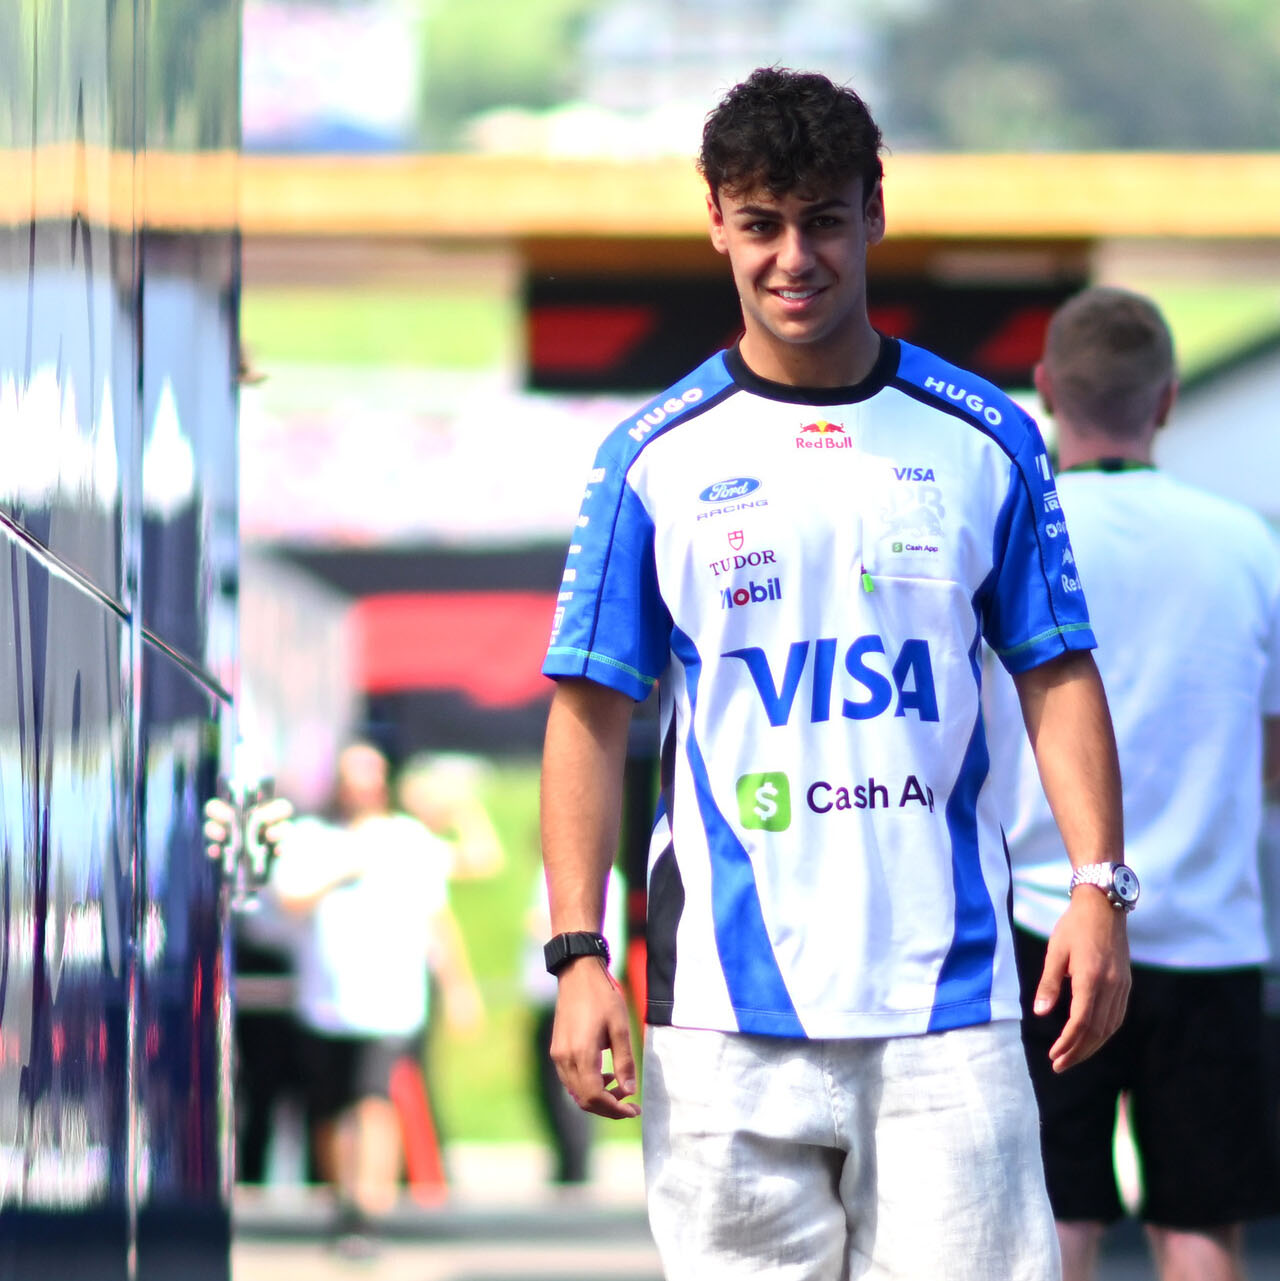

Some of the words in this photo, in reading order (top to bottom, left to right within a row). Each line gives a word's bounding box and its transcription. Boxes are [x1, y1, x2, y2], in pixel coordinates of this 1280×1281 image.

[924, 376, 1002, 425] HUGO
[628, 388, 703, 442] HUGO
[795, 437, 823, 449] Red
[825, 436, 853, 449] Bull
[891, 467, 936, 482] VISA
[708, 480, 750, 501] Ford
[696, 499, 769, 521] RACING
[709, 550, 777, 576] TUDOR
[720, 634, 940, 727] VISA
[806, 777, 889, 814] Cash
[899, 774, 935, 814] Ap
